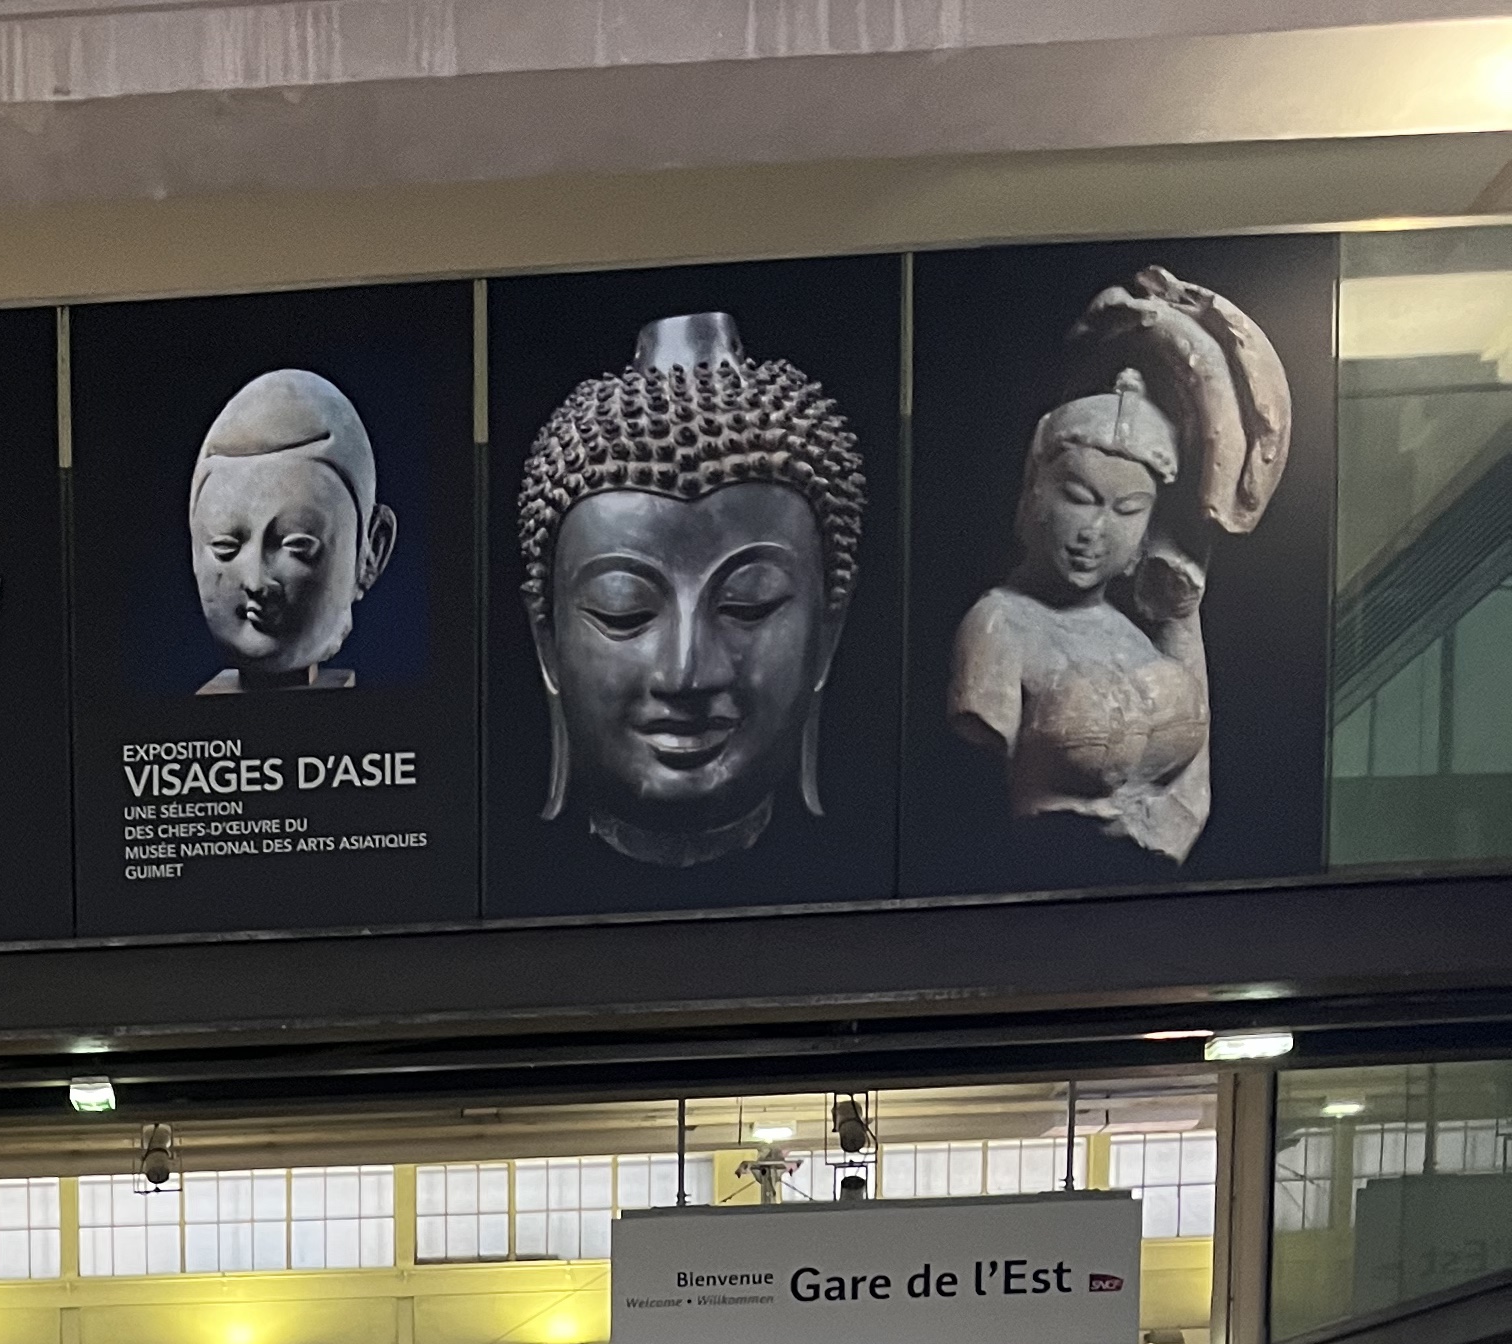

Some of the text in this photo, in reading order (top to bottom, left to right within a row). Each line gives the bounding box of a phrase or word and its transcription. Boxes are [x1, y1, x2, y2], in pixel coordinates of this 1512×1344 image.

[122, 740, 242, 762] EXPOSITION
[124, 752, 416, 796] VISAGES D'ASIE
[124, 800, 244, 820] UNE SÉLECTION
[124, 825, 154, 840] DES
[286, 817, 308, 833] DU
[124, 832, 428, 860] MUSÉE NATIONAL DES ARTS ASIATIQUES
[124, 863, 184, 880] GUIMET
[676, 1271, 775, 1288] Bienvenue
[790, 1259, 1073, 1303] Gare de l'Est
